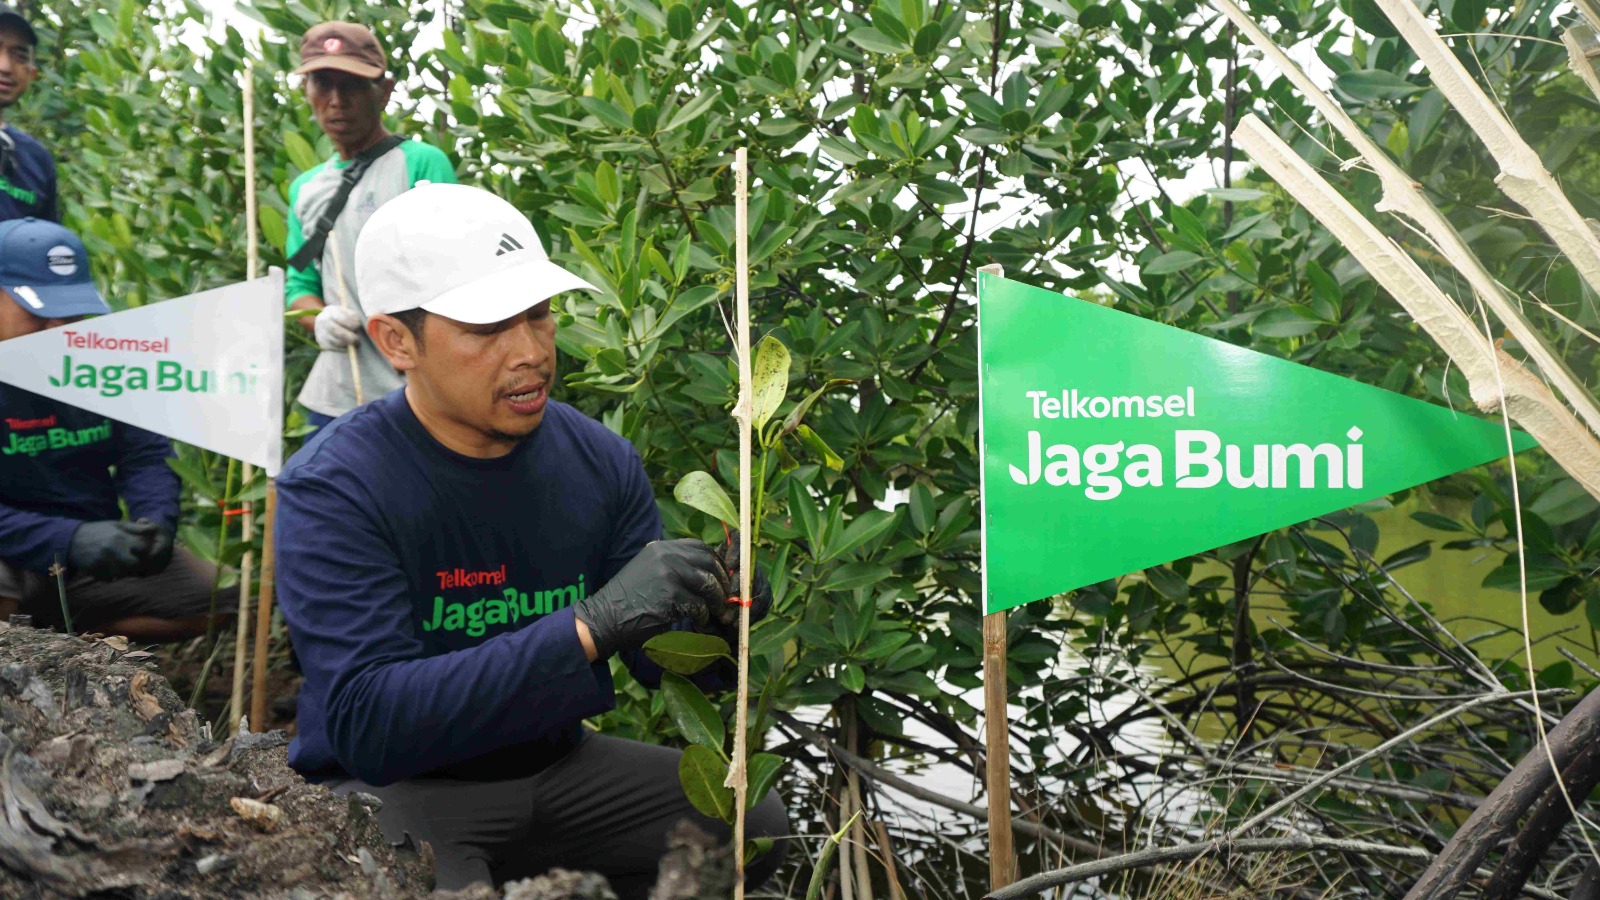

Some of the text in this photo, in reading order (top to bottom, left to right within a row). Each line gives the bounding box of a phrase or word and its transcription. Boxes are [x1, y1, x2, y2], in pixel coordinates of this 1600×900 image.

[63, 331, 169, 353] Telkomsel
[48, 355, 148, 397] Jaga
[1026, 386, 1196, 419] Telkomsel
[2, 419, 111, 456] Jaga Bumi
[1008, 425, 1364, 501] Jaga Bumi
[423, 596, 508, 637] Jaga
